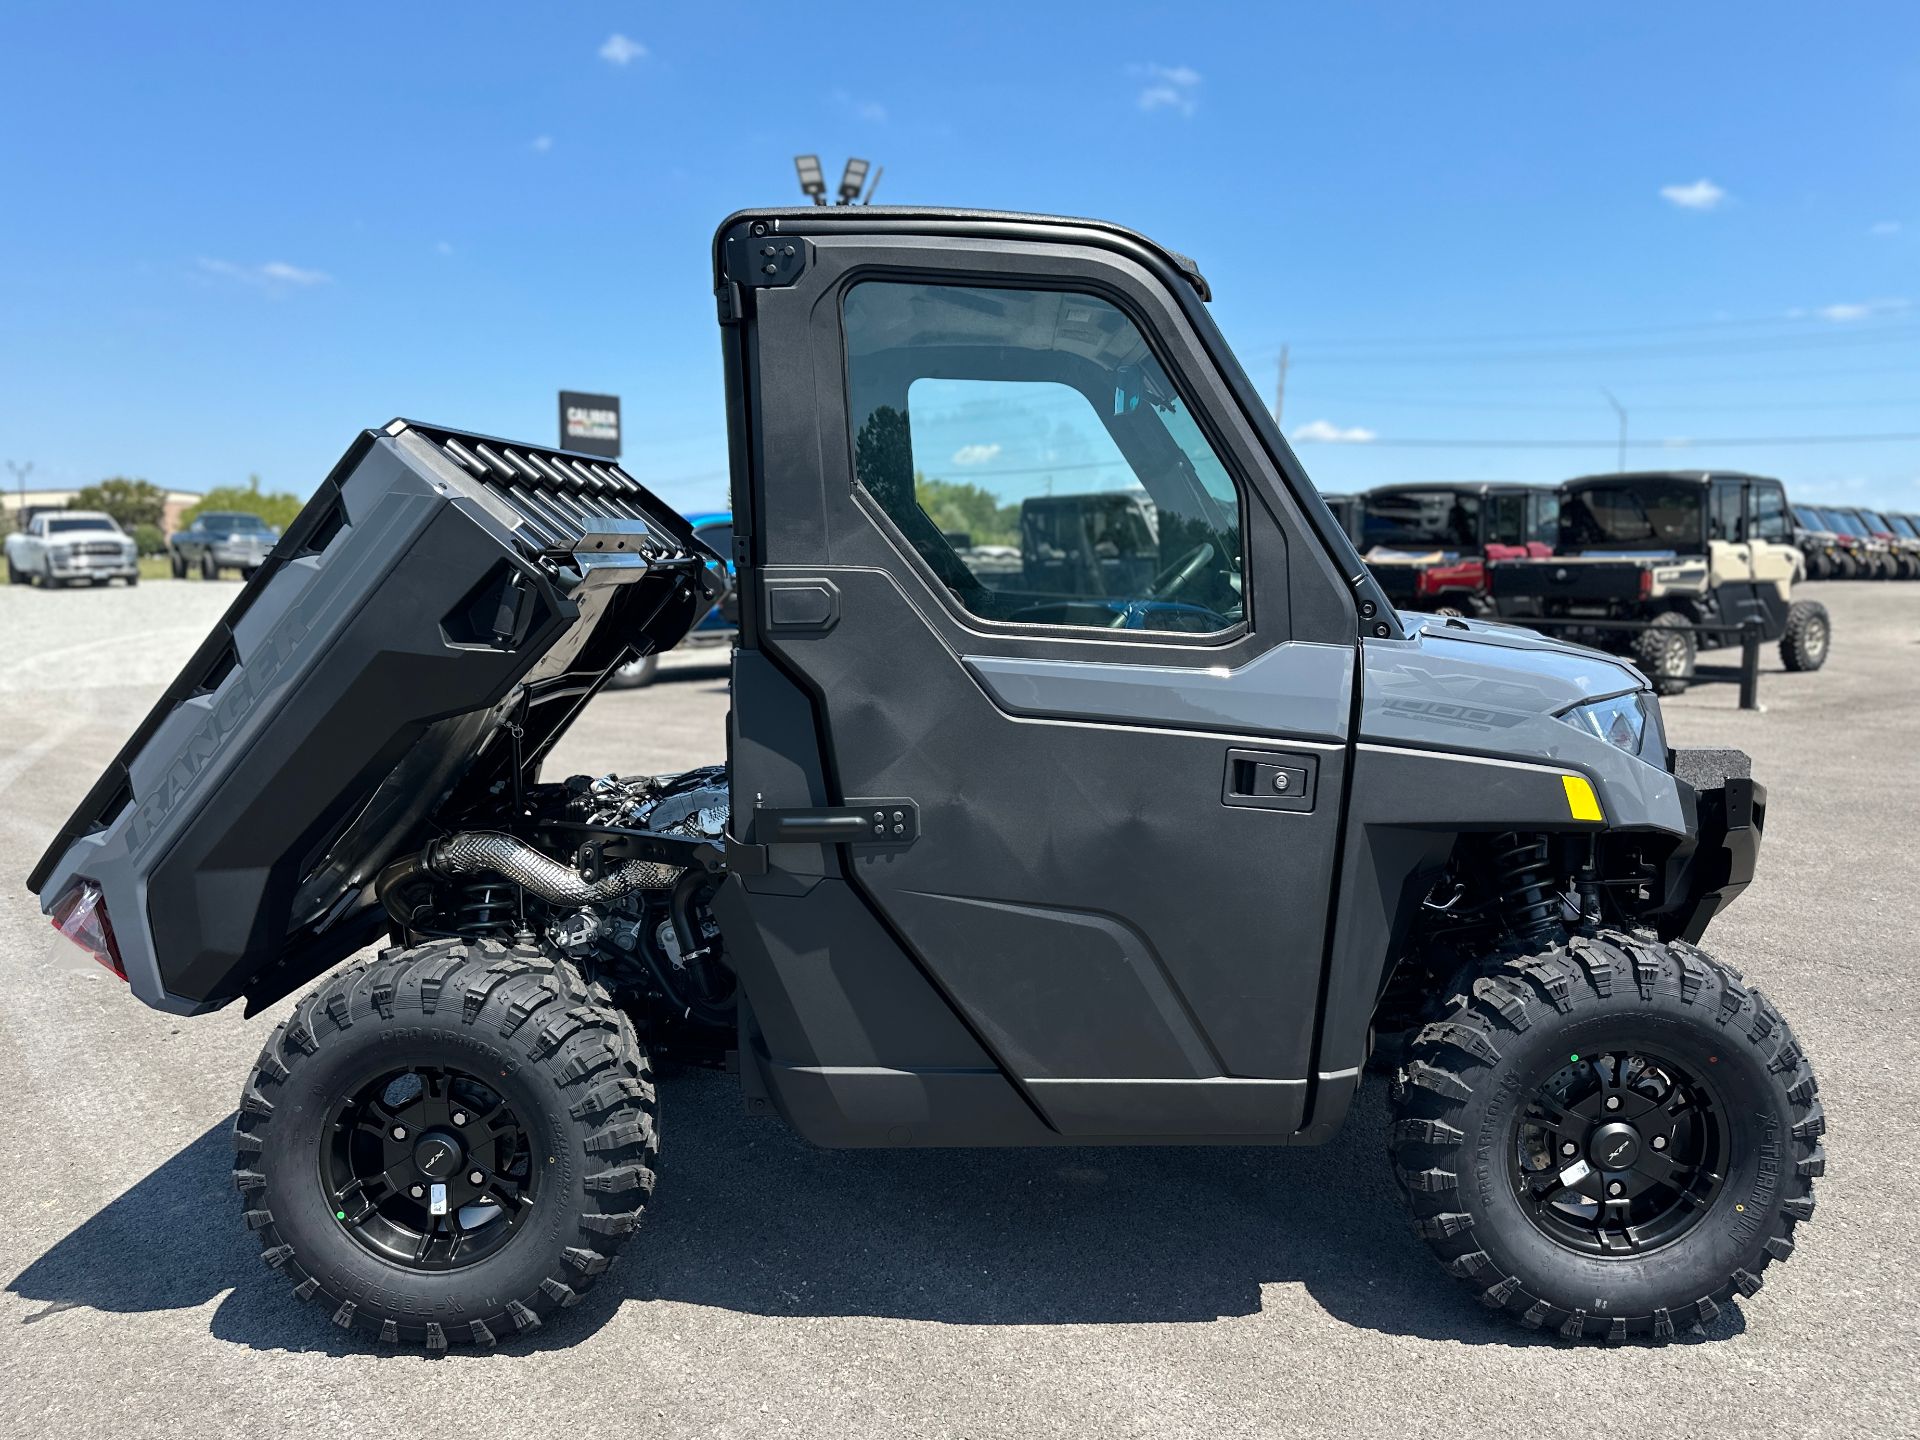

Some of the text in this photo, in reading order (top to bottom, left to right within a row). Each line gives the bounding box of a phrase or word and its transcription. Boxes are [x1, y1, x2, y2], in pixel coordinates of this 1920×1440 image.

[132, 605, 310, 849] RANGER
[1384, 664, 1560, 714] XP
[1728, 1111, 1782, 1246] X-TERRAIN
